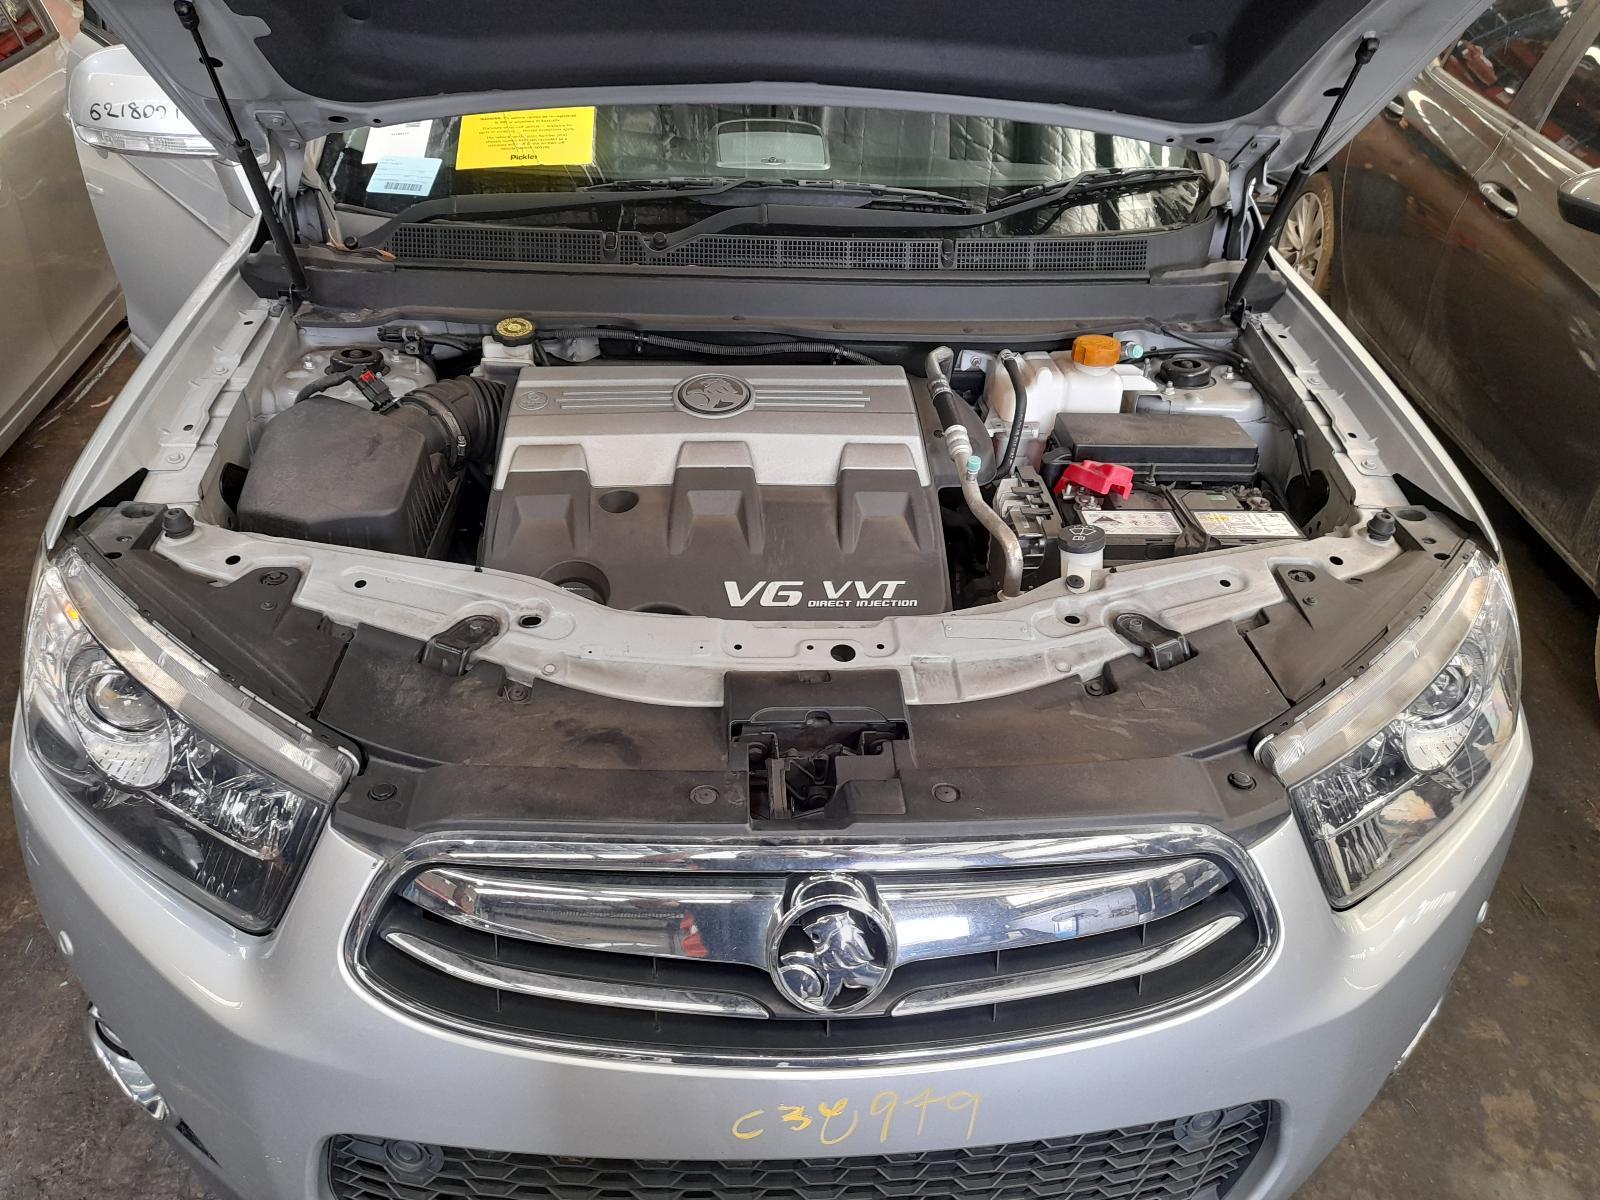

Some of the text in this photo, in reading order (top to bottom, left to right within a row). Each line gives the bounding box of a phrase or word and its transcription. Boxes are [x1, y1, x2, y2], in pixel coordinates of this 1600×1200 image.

[724, 580, 907, 607] V6 VVT
[808, 599, 918, 608] DIRECT INJECTION
